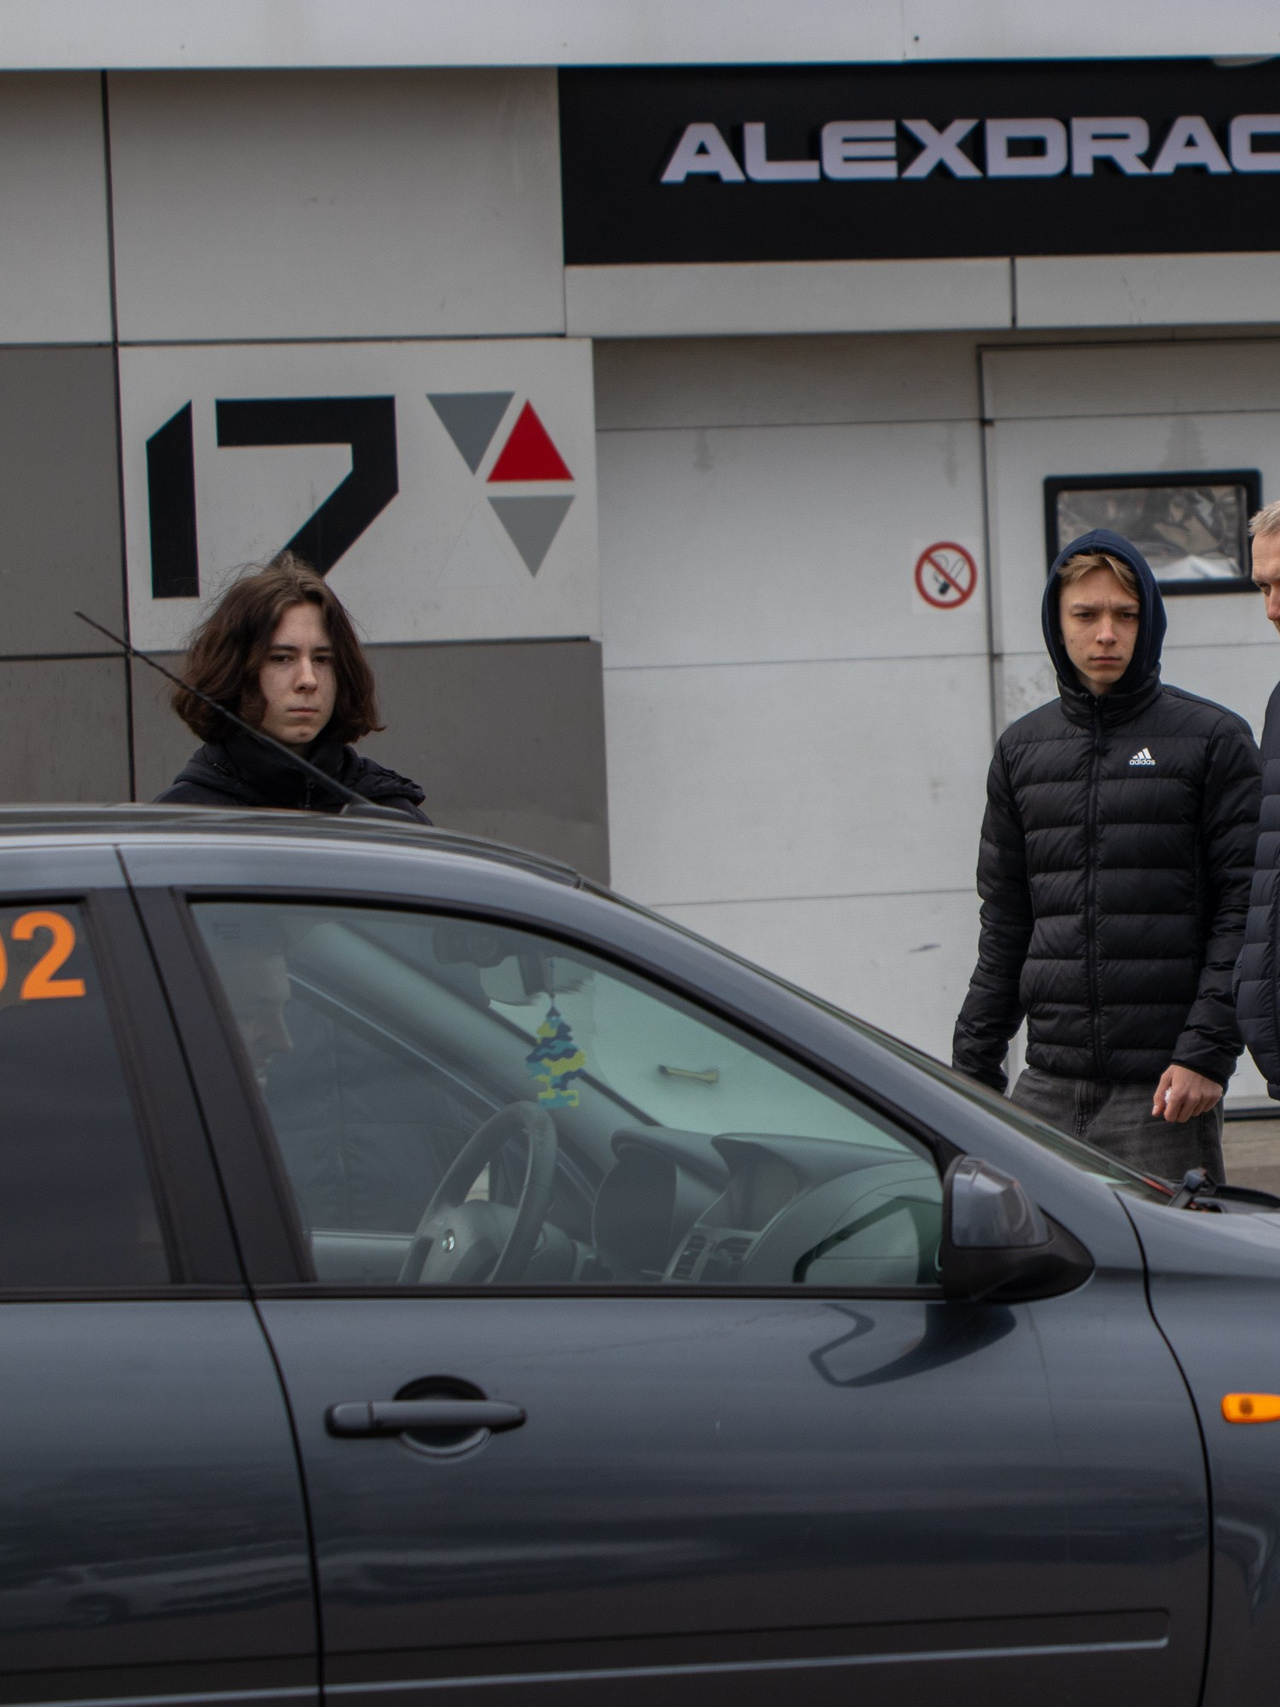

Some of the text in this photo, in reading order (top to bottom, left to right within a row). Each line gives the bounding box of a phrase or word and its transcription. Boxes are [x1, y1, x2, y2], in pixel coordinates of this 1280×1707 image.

[146, 395, 399, 600] 17
[1129, 757, 1156, 766] adidas
[0, 910, 87, 1000] 2
